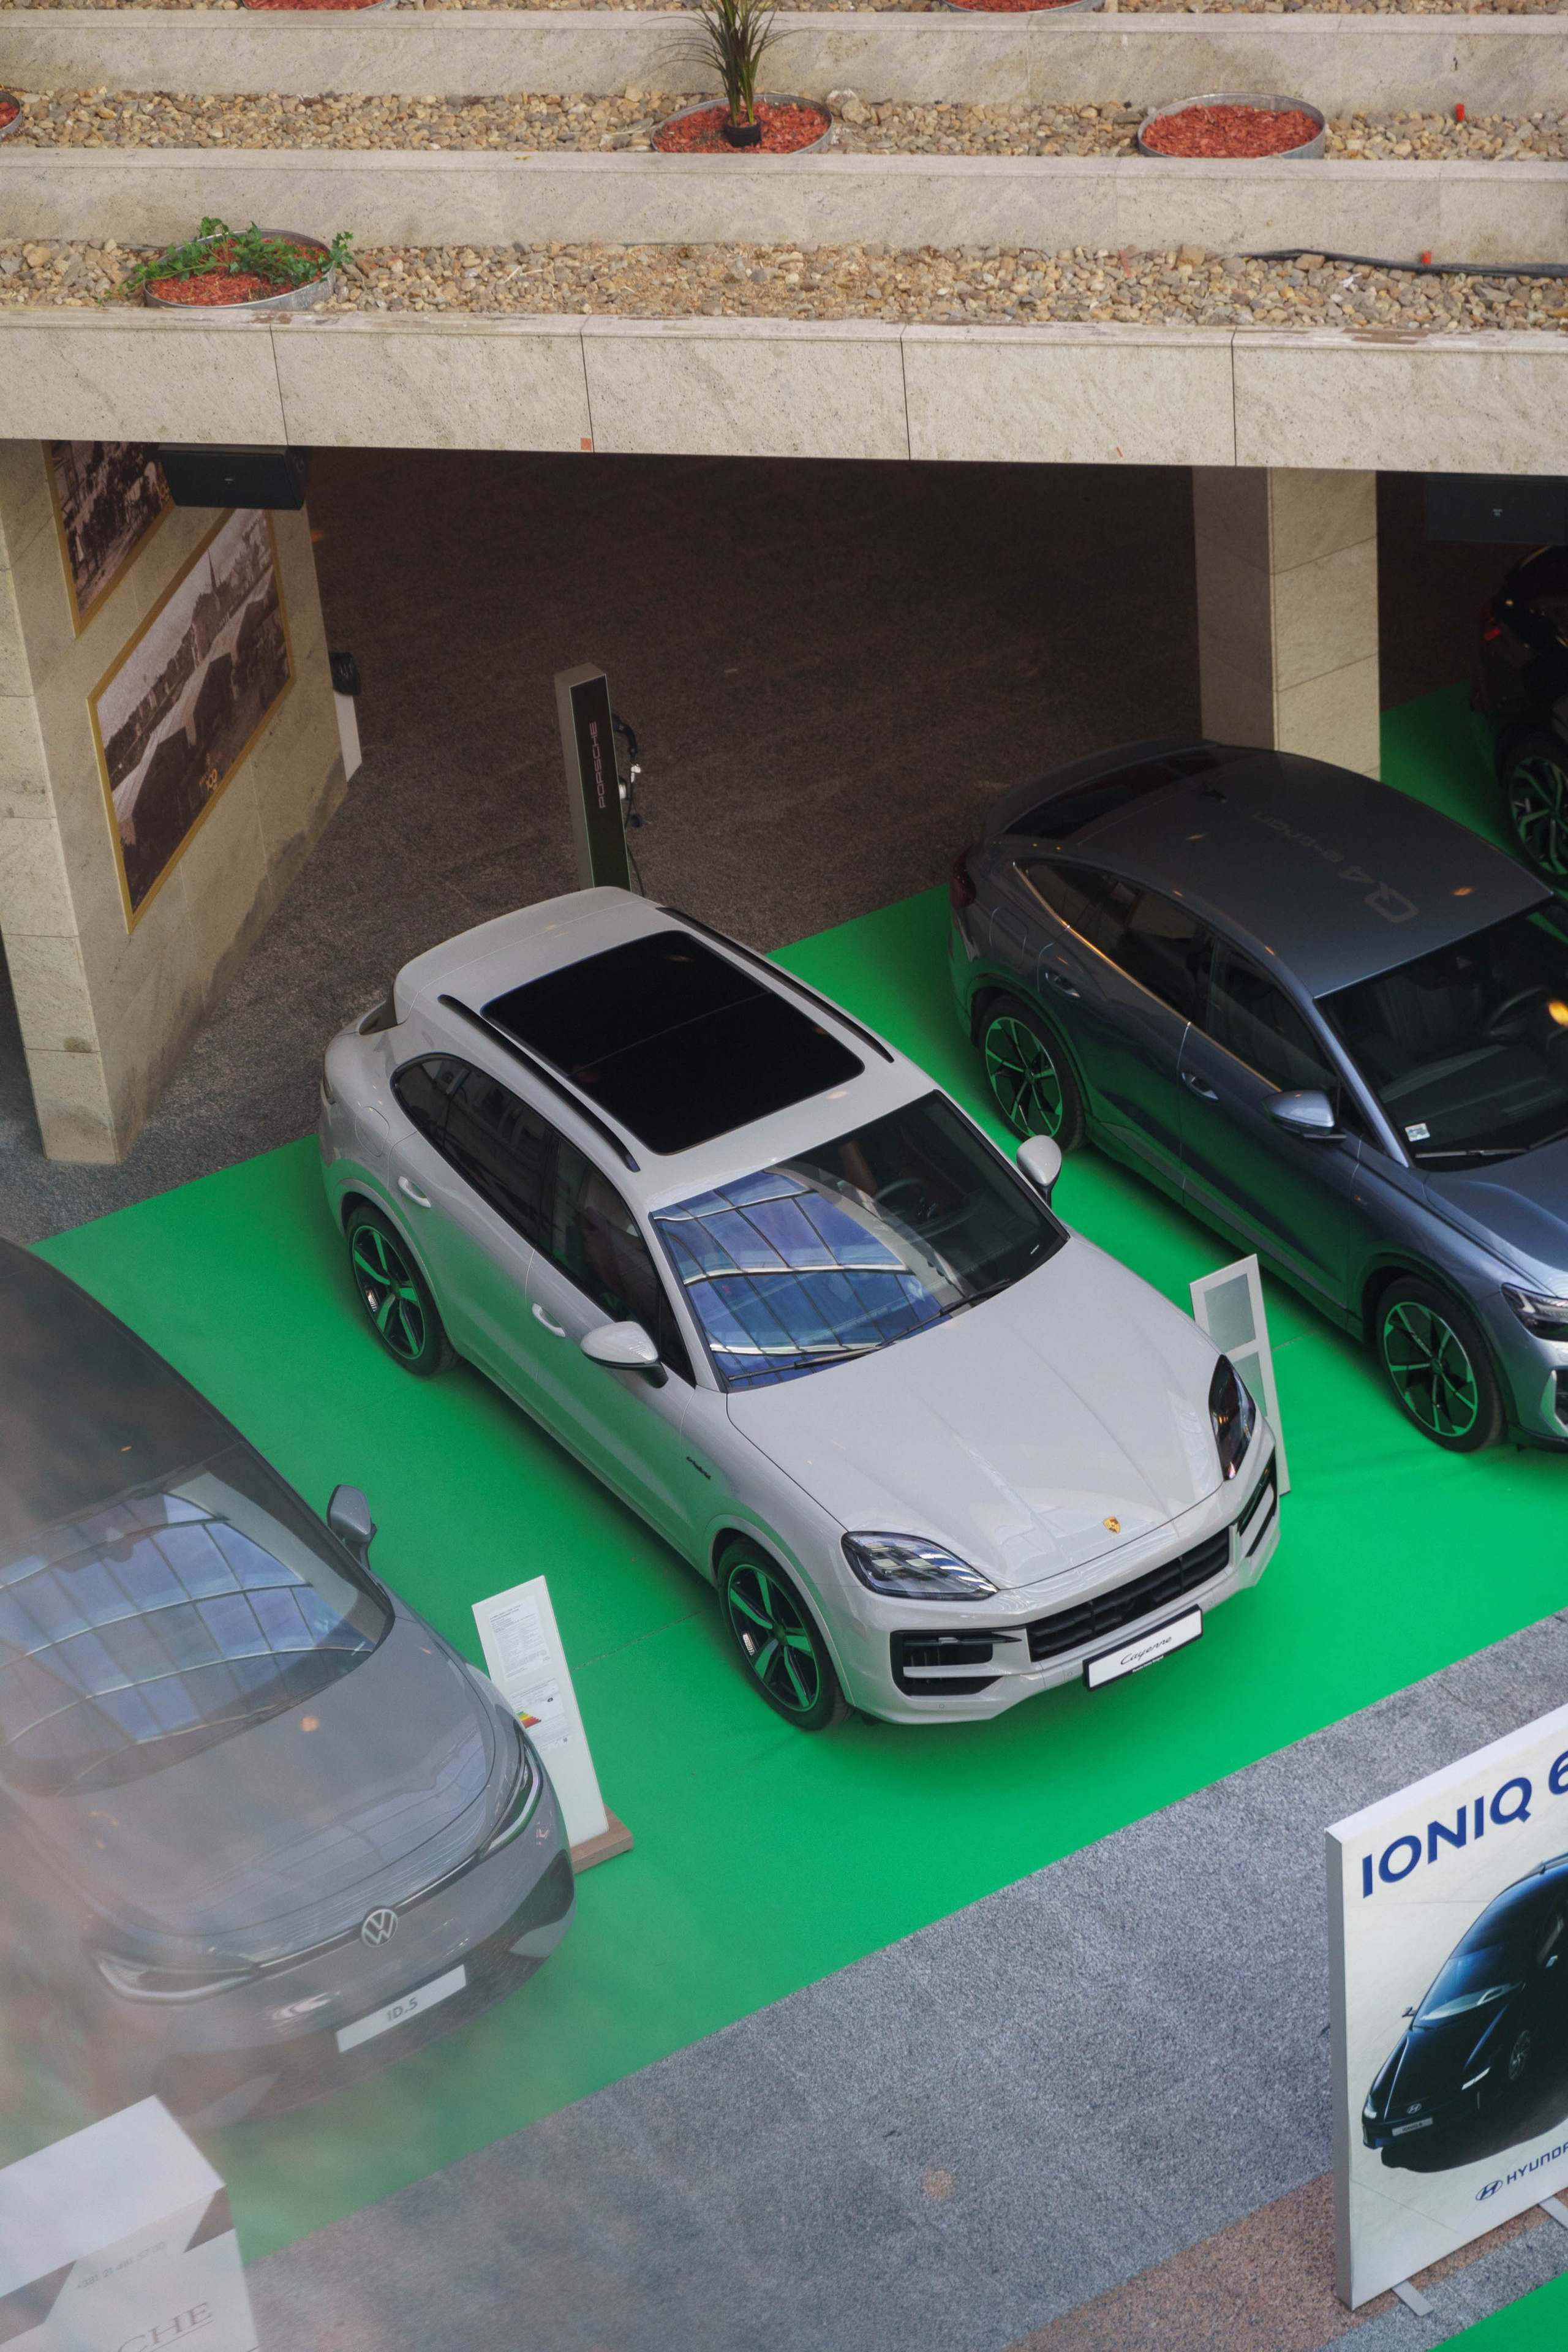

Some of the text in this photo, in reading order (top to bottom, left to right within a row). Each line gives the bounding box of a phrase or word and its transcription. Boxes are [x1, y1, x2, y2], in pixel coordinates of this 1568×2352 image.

[589, 721, 606, 809] PORSCHE
[1337, 865, 1419, 923] Q4
[1120, 1636, 1172, 1665] Cayenne
[1362, 1777, 1532, 1899] IONIQ
[386, 1997, 418, 2021] ID.5
